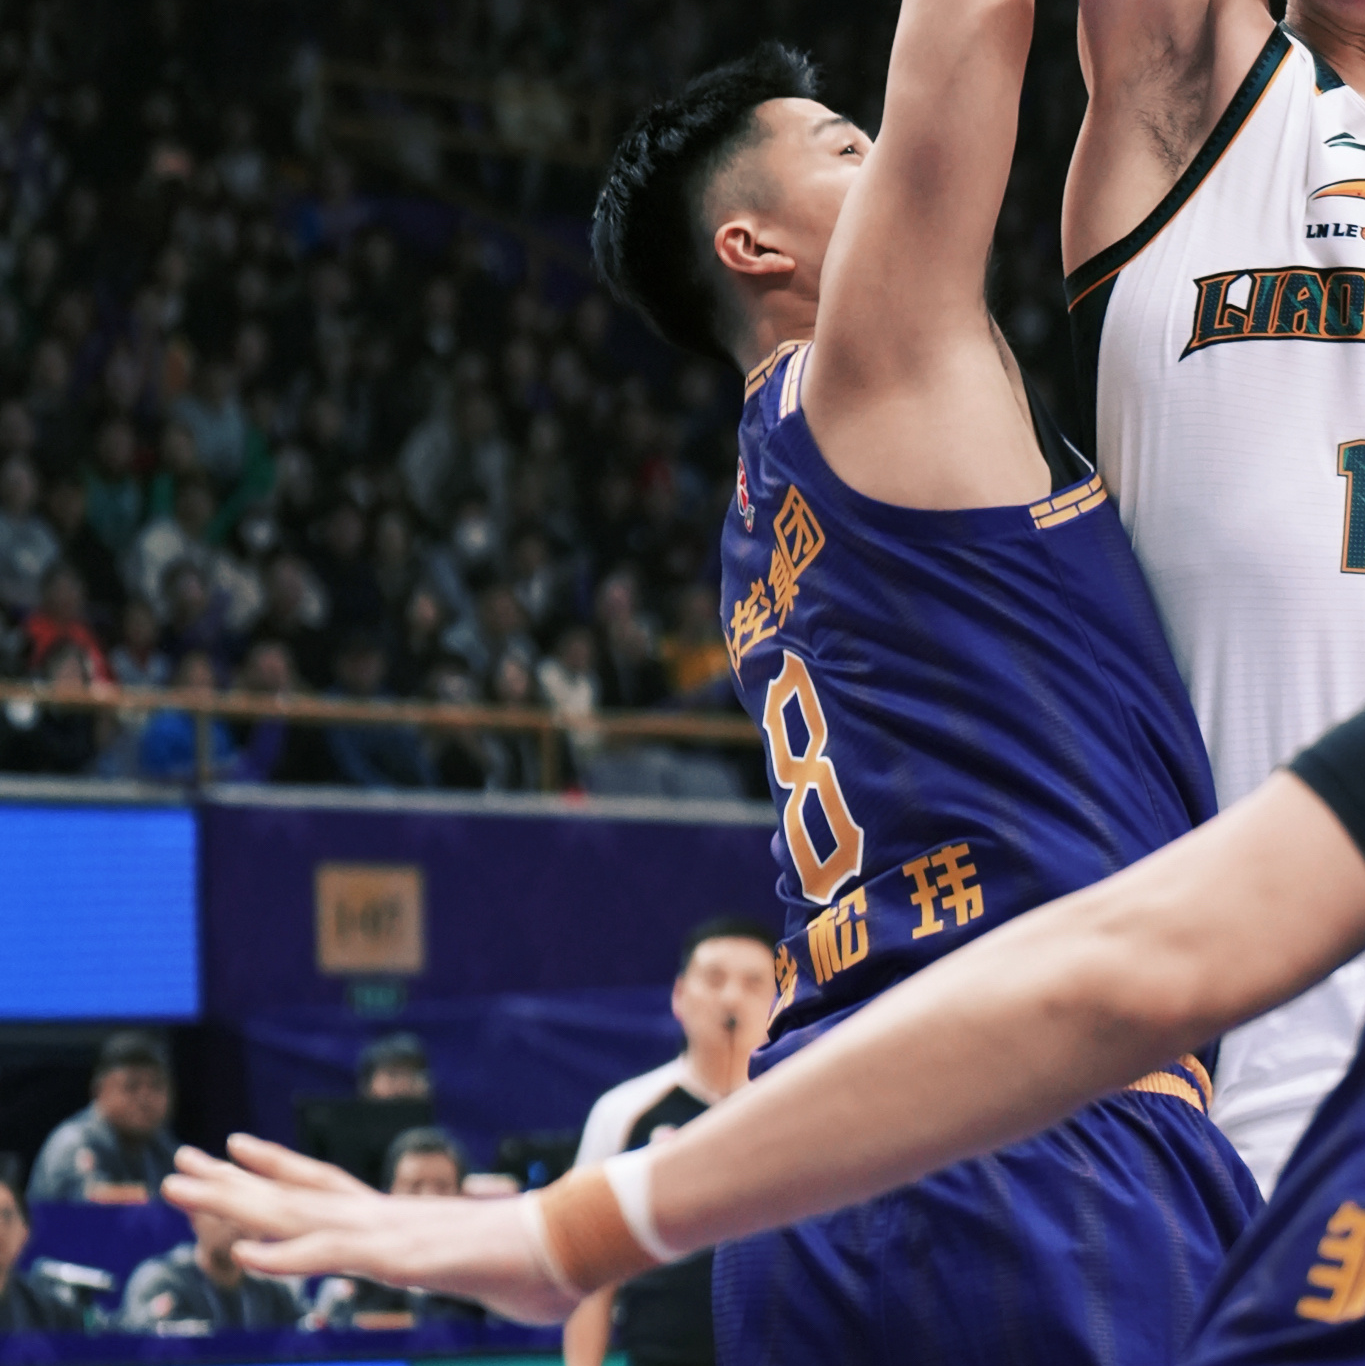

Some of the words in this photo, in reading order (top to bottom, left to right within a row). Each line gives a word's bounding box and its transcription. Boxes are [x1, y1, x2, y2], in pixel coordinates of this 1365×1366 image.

[724, 484, 826, 690] 控集团
[762, 649, 865, 905] 8
